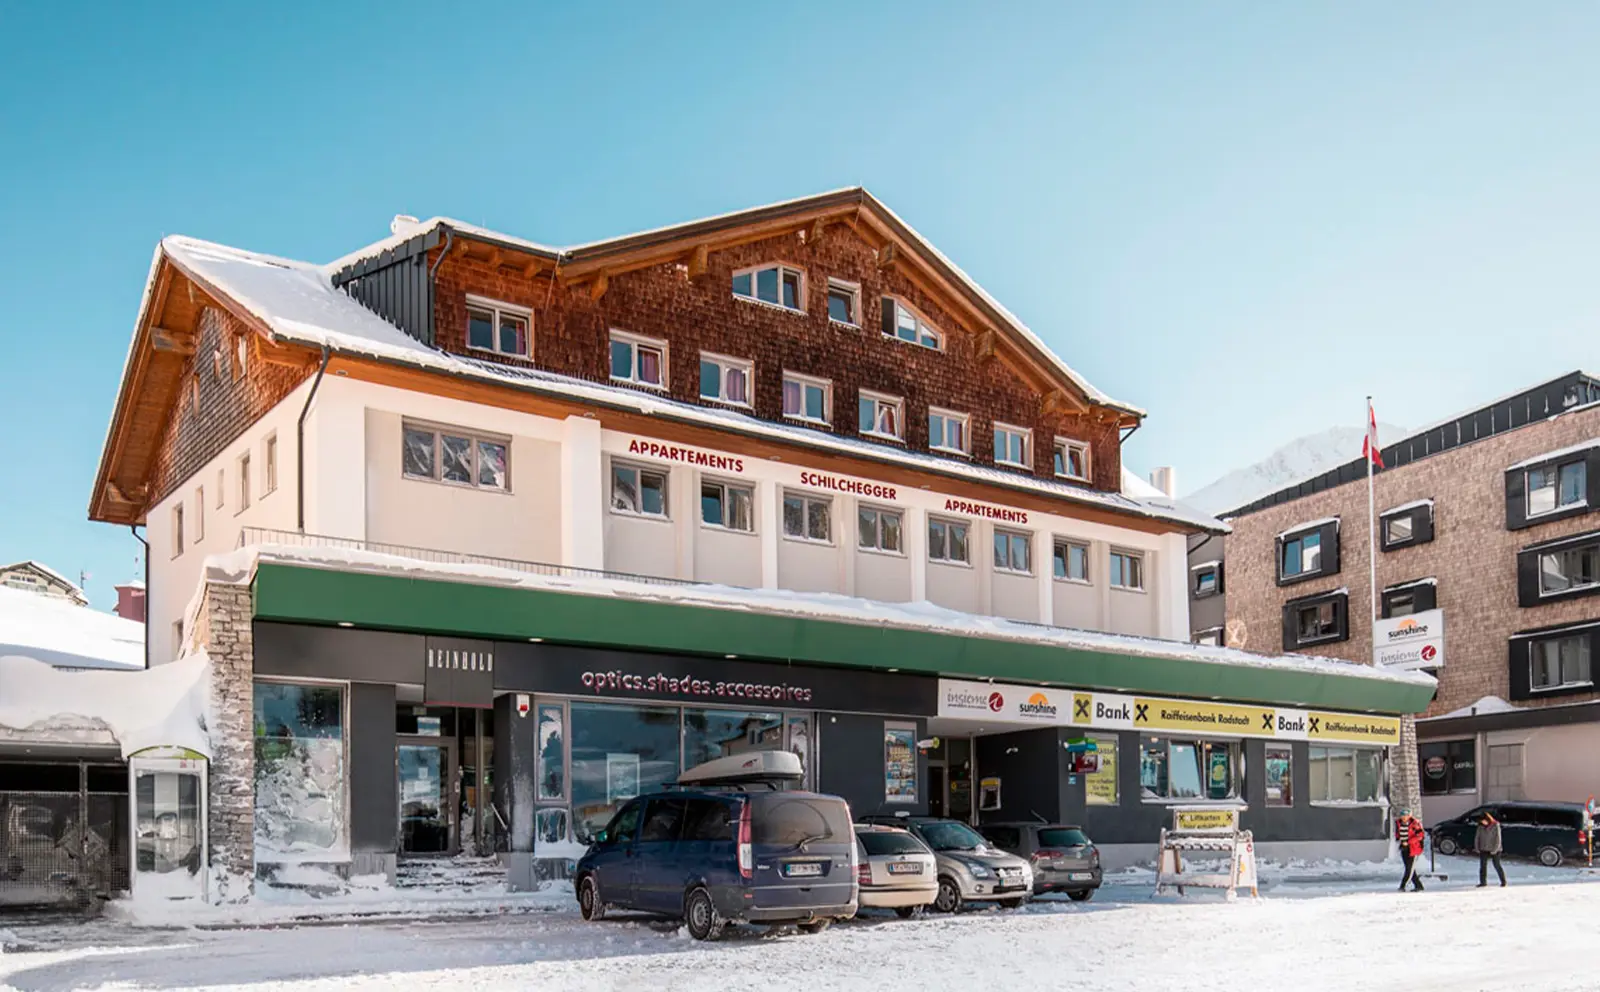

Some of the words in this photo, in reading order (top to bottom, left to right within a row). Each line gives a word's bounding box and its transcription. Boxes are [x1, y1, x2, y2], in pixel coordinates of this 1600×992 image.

[629, 439, 744, 472] APPARTEMENTS
[800, 472, 897, 500] SCHILCHEGGER
[945, 499, 1028, 524] APPARTEMENTS
[1388, 624, 1429, 638] sunshine
[1380, 650, 1420, 664] insieme
[581, 670, 812, 701] optics.shades.accessoires
[947, 688, 988, 706] insieme
[1019, 701, 1057, 715] sunshine
[1096, 702, 1130, 721] Bank
[1160, 709, 1216, 724] Raiffeisenbank
[1218, 713, 1250, 726] Radstadt
[1278, 716, 1305, 732] Bank
[1325, 721, 1369, 734] Raiffeisenbank
[1370, 725, 1397, 736] Radstadt
